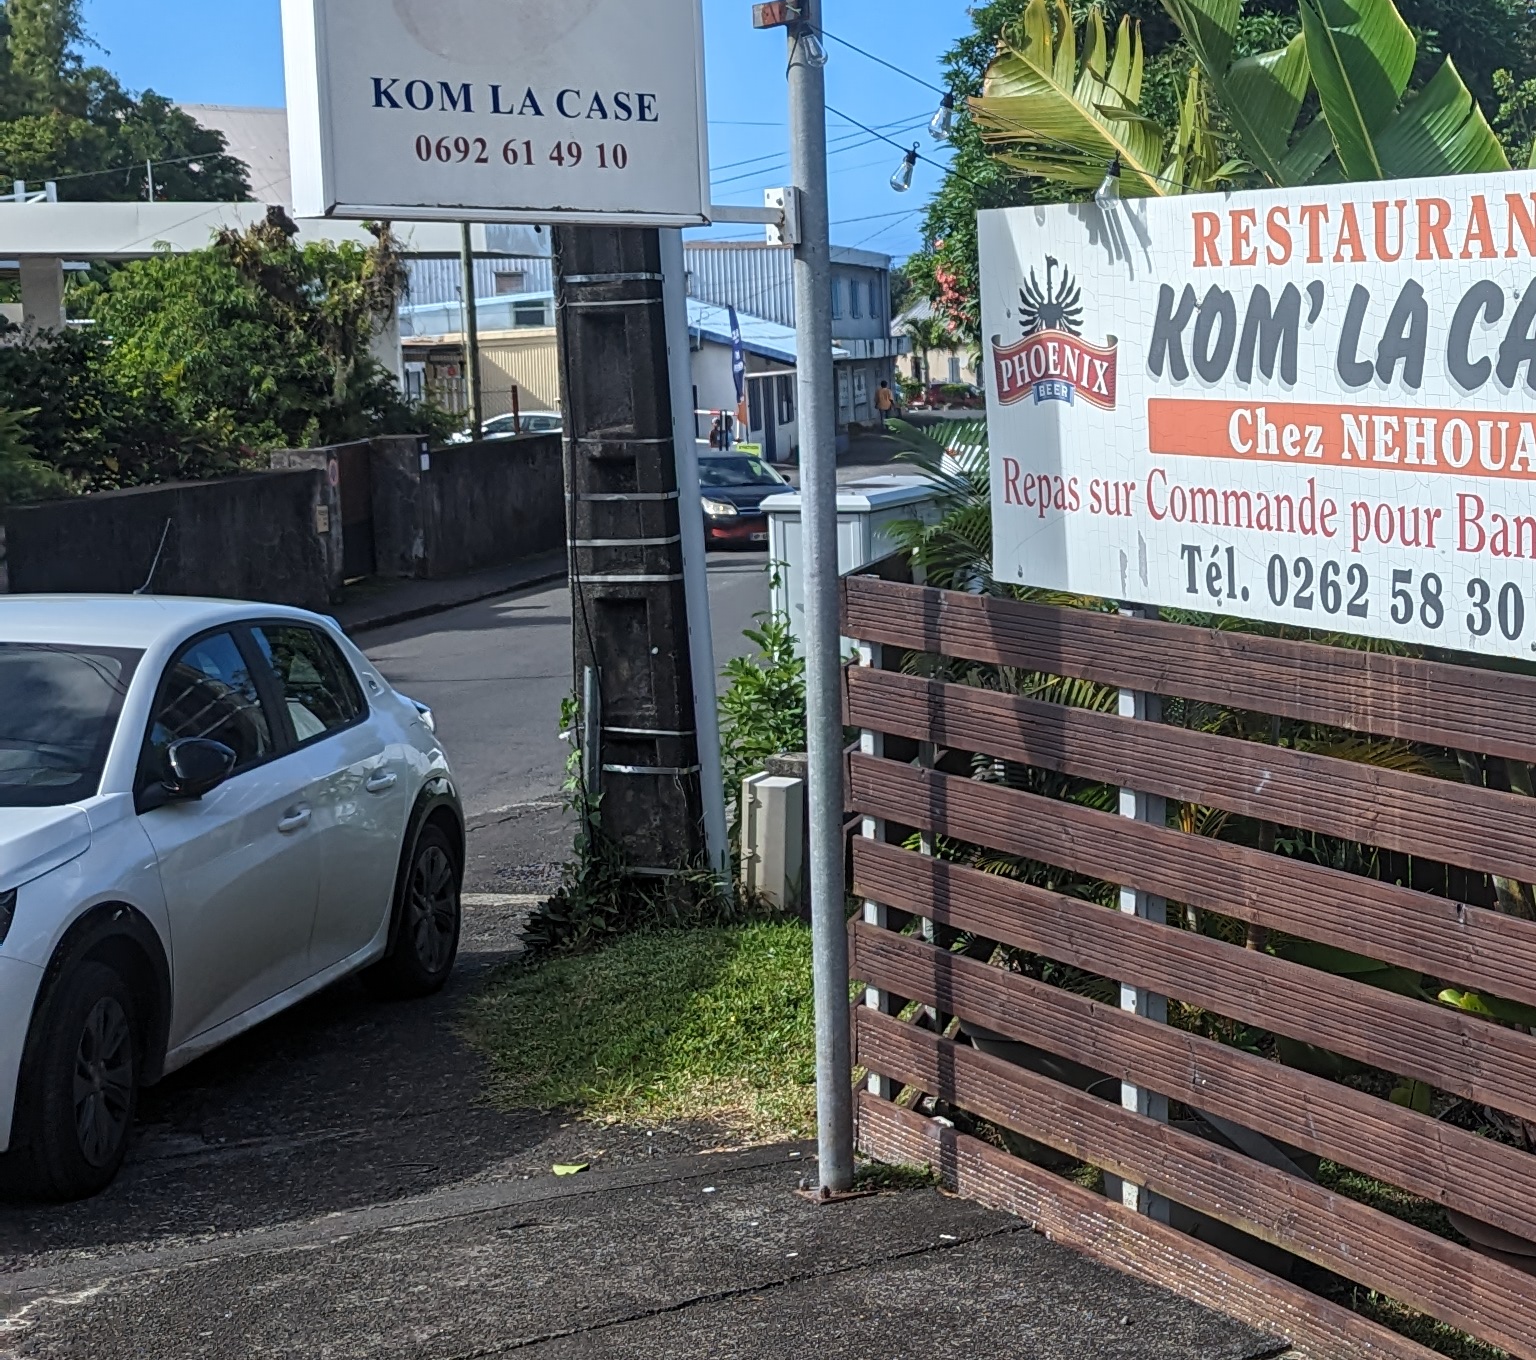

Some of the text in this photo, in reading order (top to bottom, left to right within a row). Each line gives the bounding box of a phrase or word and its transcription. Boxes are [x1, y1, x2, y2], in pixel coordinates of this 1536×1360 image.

[370, 77, 660, 123] KOM LA CASE
[415, 134, 628, 170] 0692 61 49 10
[1146, 280, 1324, 389] KOM'
[1336, 278, 1429, 393] LA
[999, 341, 1110, 397] PHOENIX
[1038, 382, 1069, 400] BEER
[1228, 406, 1324, 459] Chez
[1003, 457, 1080, 518] Repas
[1089, 479, 1135, 517] sur
[1147, 468, 1337, 538] Commande
[1350, 500, 1442, 553] pour
[1180, 543, 1250, 603] Tél.
[1267, 553, 1370, 619] 0262
[1390, 568, 1444, 629] 58
[1466, 577, 1525, 641] 30
